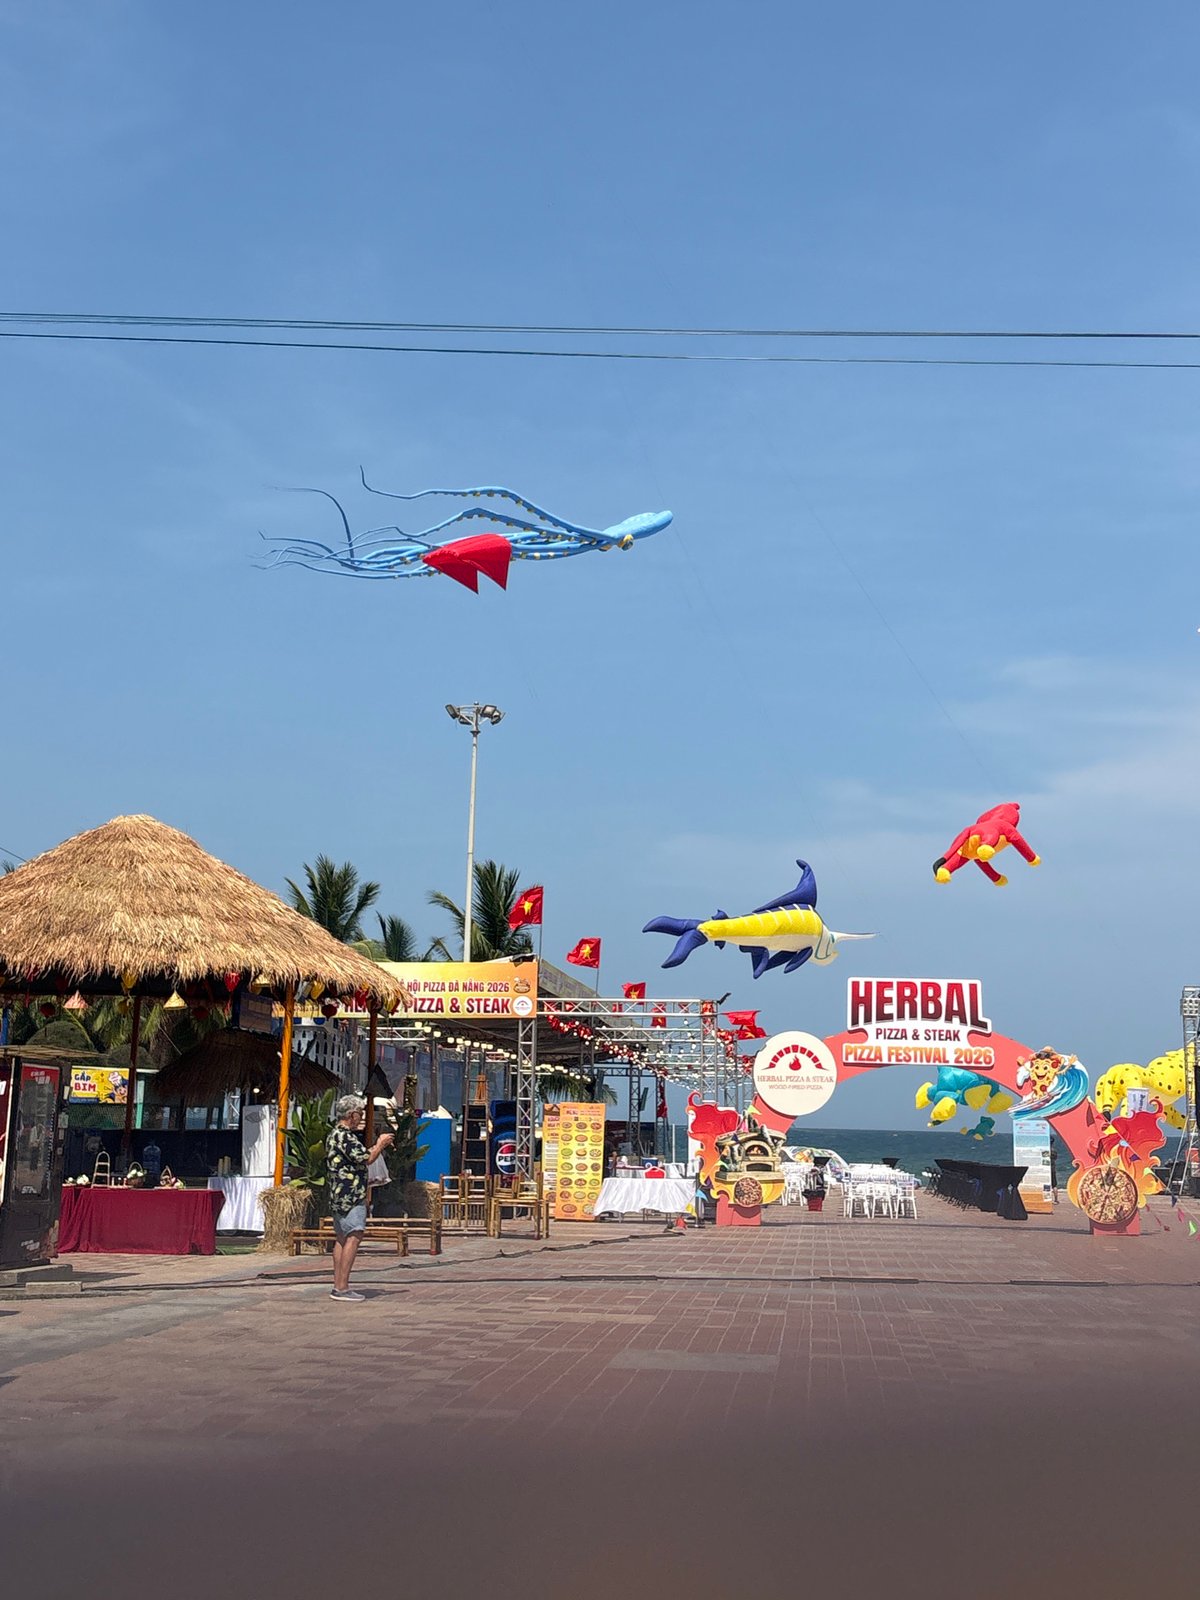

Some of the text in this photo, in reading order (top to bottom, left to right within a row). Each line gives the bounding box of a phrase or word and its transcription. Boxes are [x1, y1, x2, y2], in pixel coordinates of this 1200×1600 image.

[407, 979, 421, 994] HỘI
[424, 981, 446, 992] PIZZA
[448, 979, 460, 992] ĐÀ
[487, 982, 510, 993] 2026
[449, 997, 460, 1013] &
[466, 997, 511, 1014] STEAK
[851, 981, 988, 1030] HERBAL
[876, 1028, 960, 1042] PIZZA & STEAK
[845, 1045, 993, 1065] PIZZA FESTIVAL 2026
[757, 1075, 834, 1083] HERBAL PIZZA & STEAK
[74, 1082, 96, 1092] BIM
[498, 1155, 517, 1163] PEP
